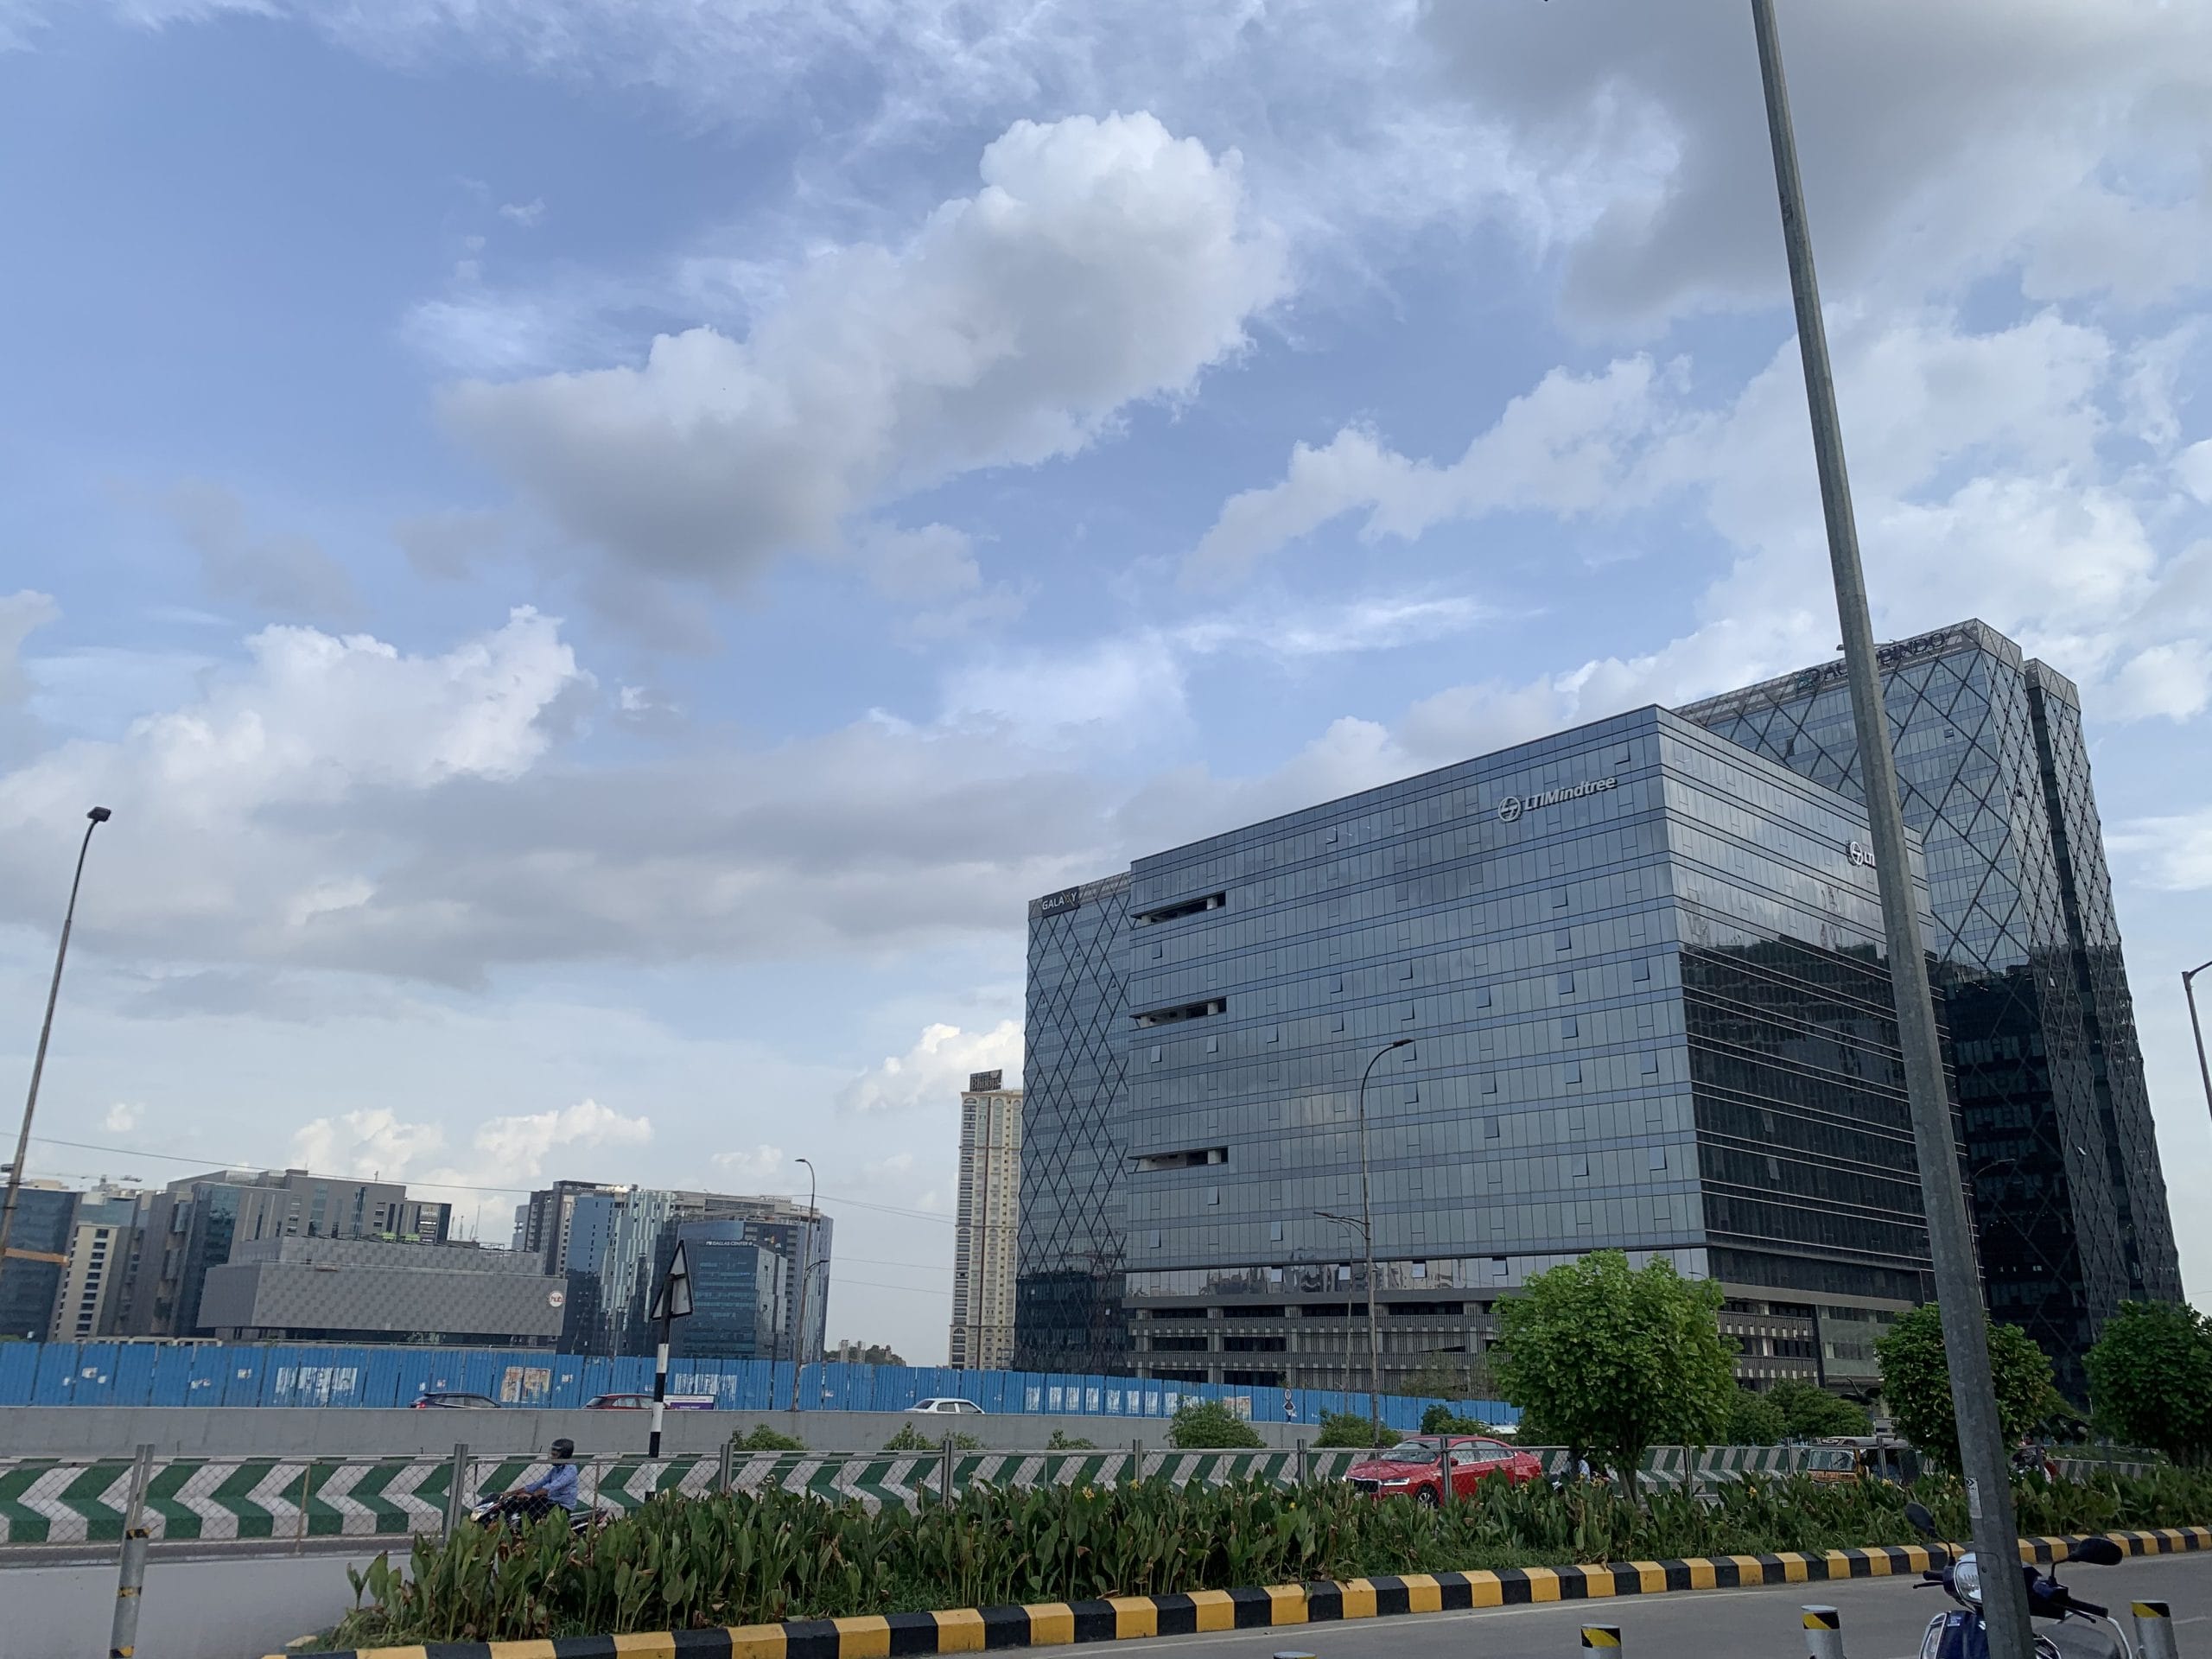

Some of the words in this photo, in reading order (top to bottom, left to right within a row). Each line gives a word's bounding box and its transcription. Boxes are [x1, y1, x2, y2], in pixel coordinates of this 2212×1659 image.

[1823, 633, 1944, 682] AUBINDO
[1524, 777, 1616, 810] LTIMindtree
[1042, 891, 1077, 910] GALAXY
